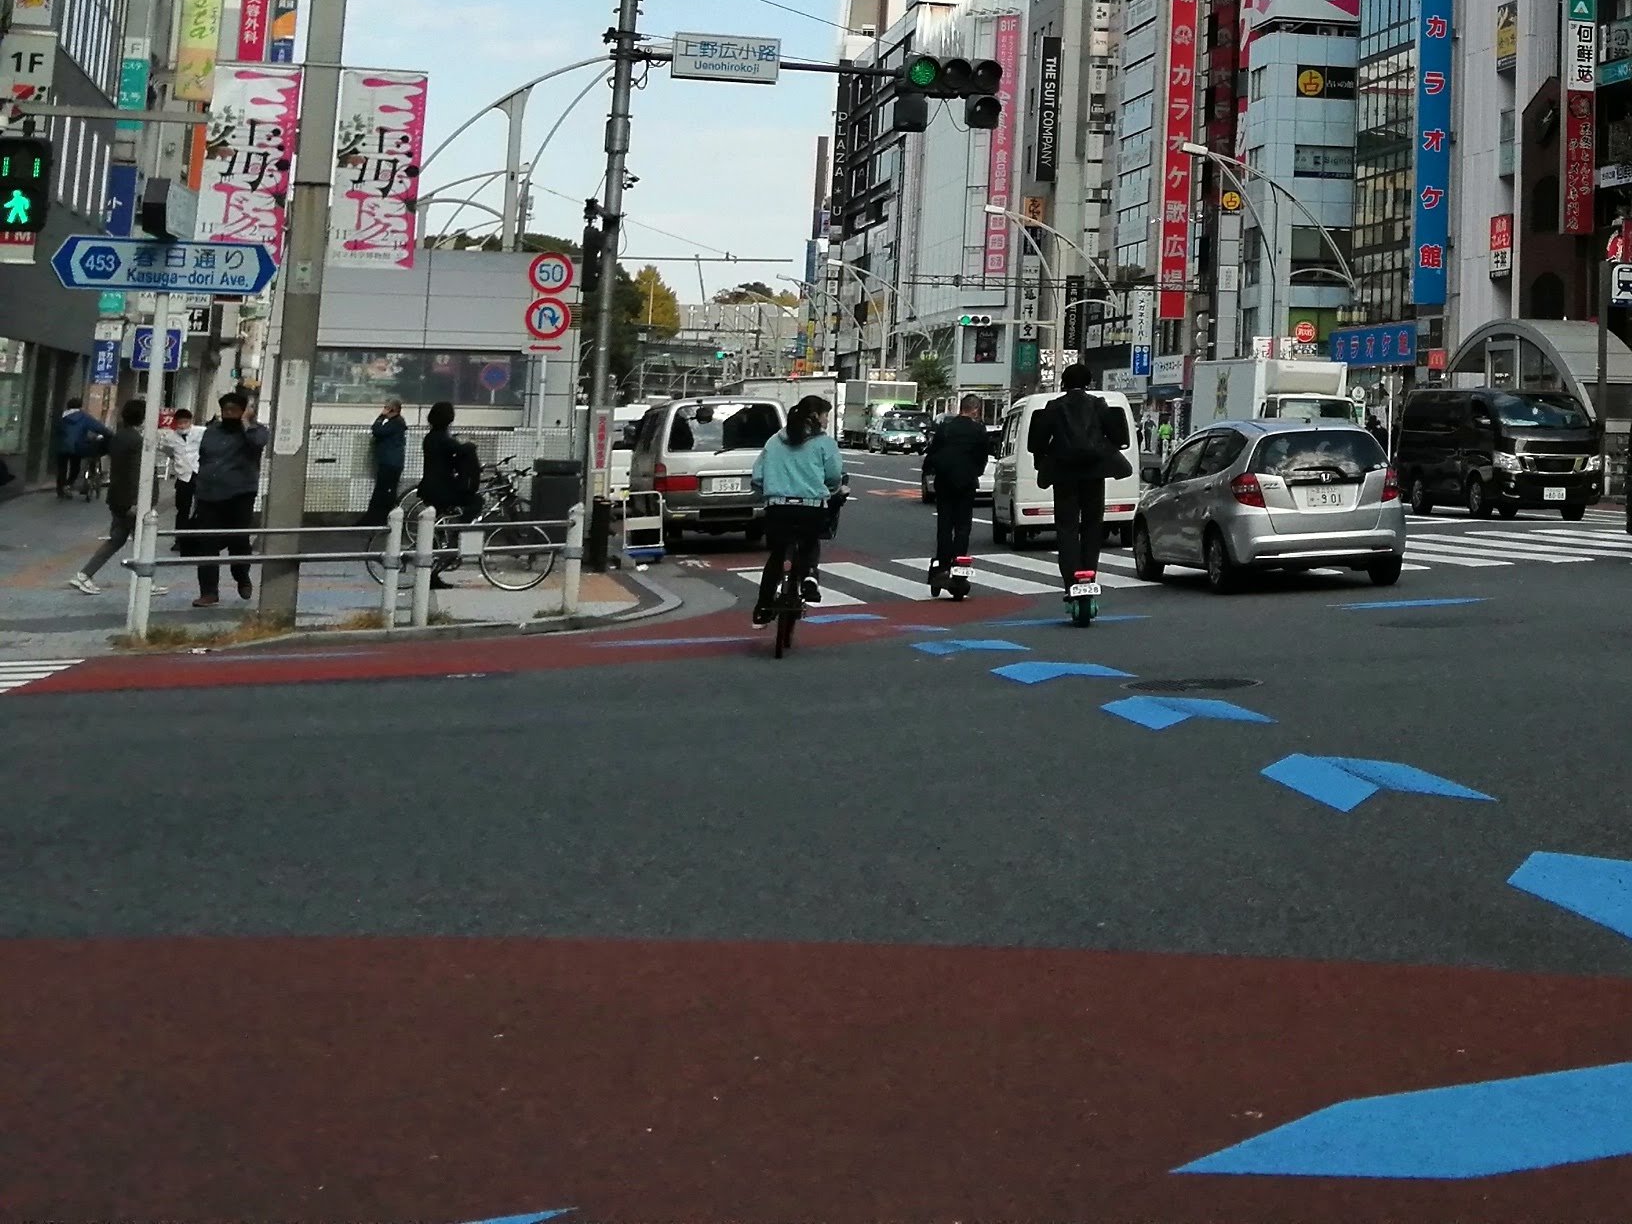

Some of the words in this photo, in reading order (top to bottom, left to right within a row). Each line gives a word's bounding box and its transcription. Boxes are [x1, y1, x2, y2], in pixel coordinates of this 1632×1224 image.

[679, 39, 777, 62] 上野広小路
[11, 51, 44, 73] 1F
[693, 60, 760, 74] Uenohirokoji
[1046, 57, 1057, 79] THE
[1302, 71, 1319, 93] 占
[1044, 82, 1056, 108] SUIT
[1041, 111, 1055, 167] COMPANY
[1418, 15, 1448, 270] カラオケ館
[85, 252, 115, 270] 453
[133, 247, 245, 270] 春日通り
[126, 268, 214, 286] Kasuga-dori
[220, 271, 250, 287] Ave.
[539, 264, 564, 282] 50
